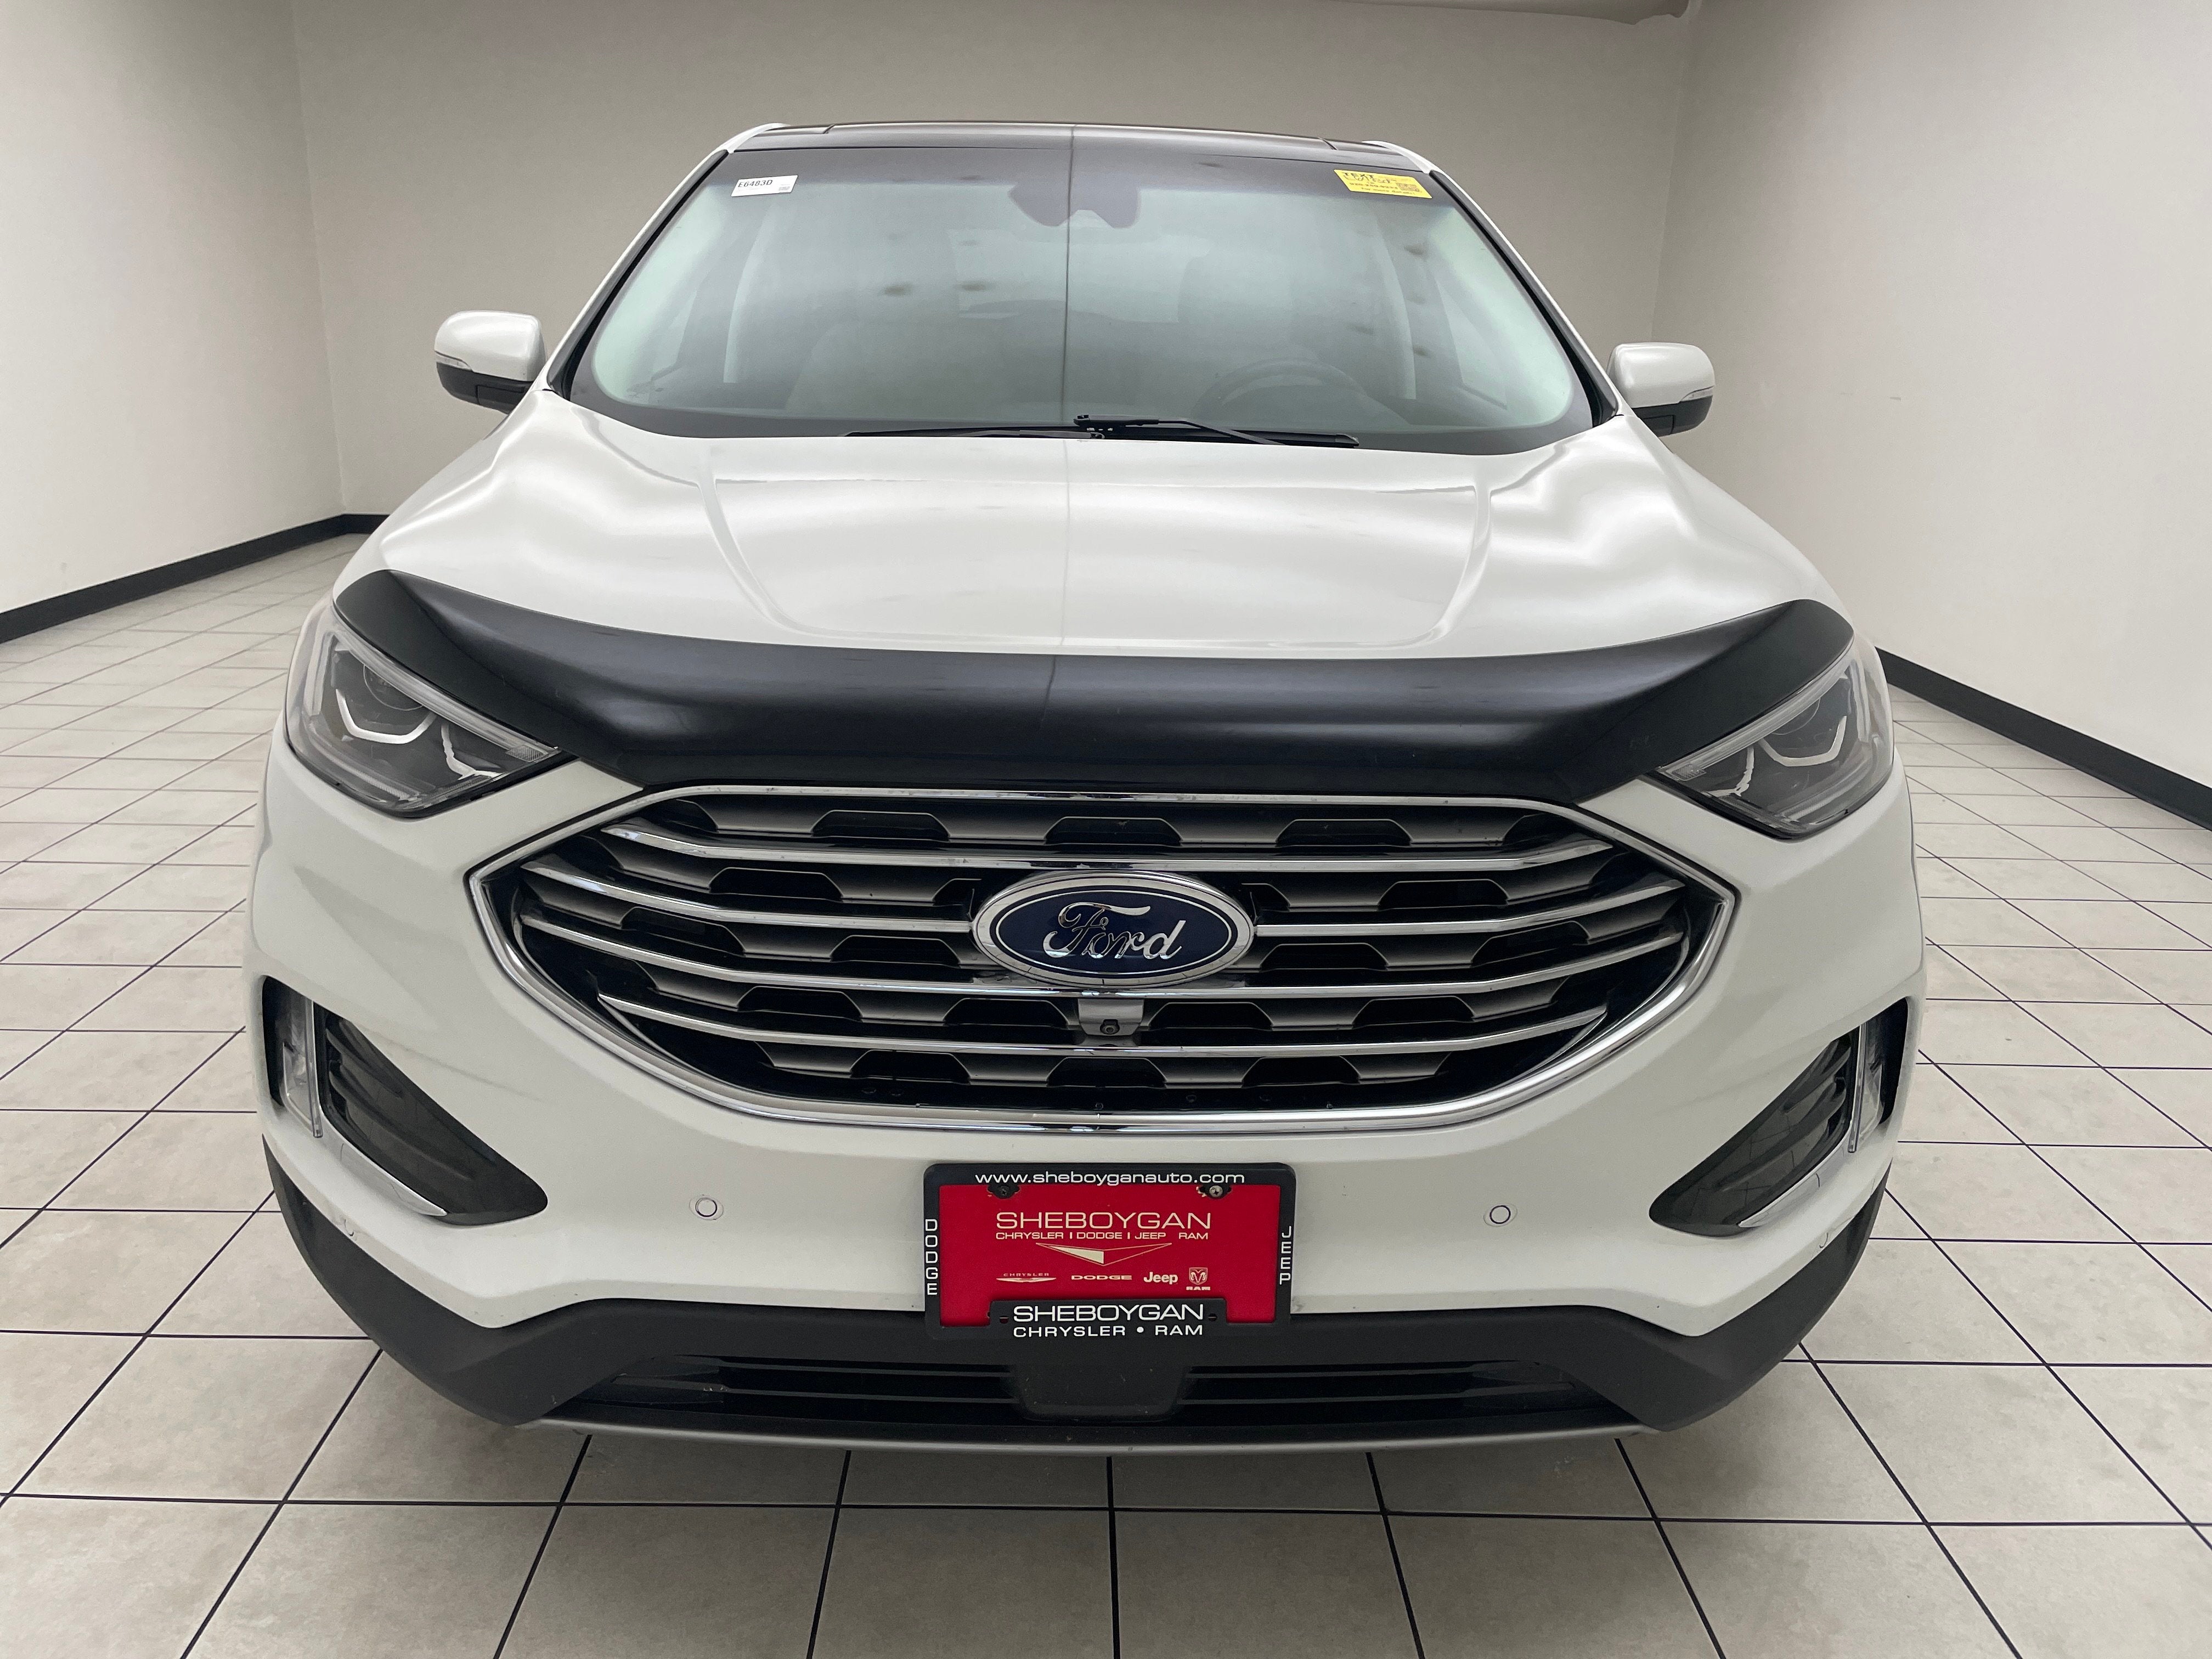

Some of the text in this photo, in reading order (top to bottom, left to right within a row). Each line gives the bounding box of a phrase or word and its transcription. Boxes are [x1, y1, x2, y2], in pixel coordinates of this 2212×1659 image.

[1042, 901, 1186, 960] Ford
[975, 1171, 1245, 1186] www.sheboyganauto.com
[996, 1211, 1211, 1229] SHEBOYGAN
[996, 1232, 1064, 1240] CHRYSLER
[1135, 1232, 1166, 1240] JEEP
[1178, 1232, 1208, 1240] RAM
[925, 1218, 939, 1295] DODGE
[1279, 1226, 1292, 1285] JEEP
[1143, 1271, 1178, 1285] Jeep
[1013, 1304, 1204, 1322] SHEBOYGAN
[1013, 1324, 1203, 1338] CHRYSLER RAM
